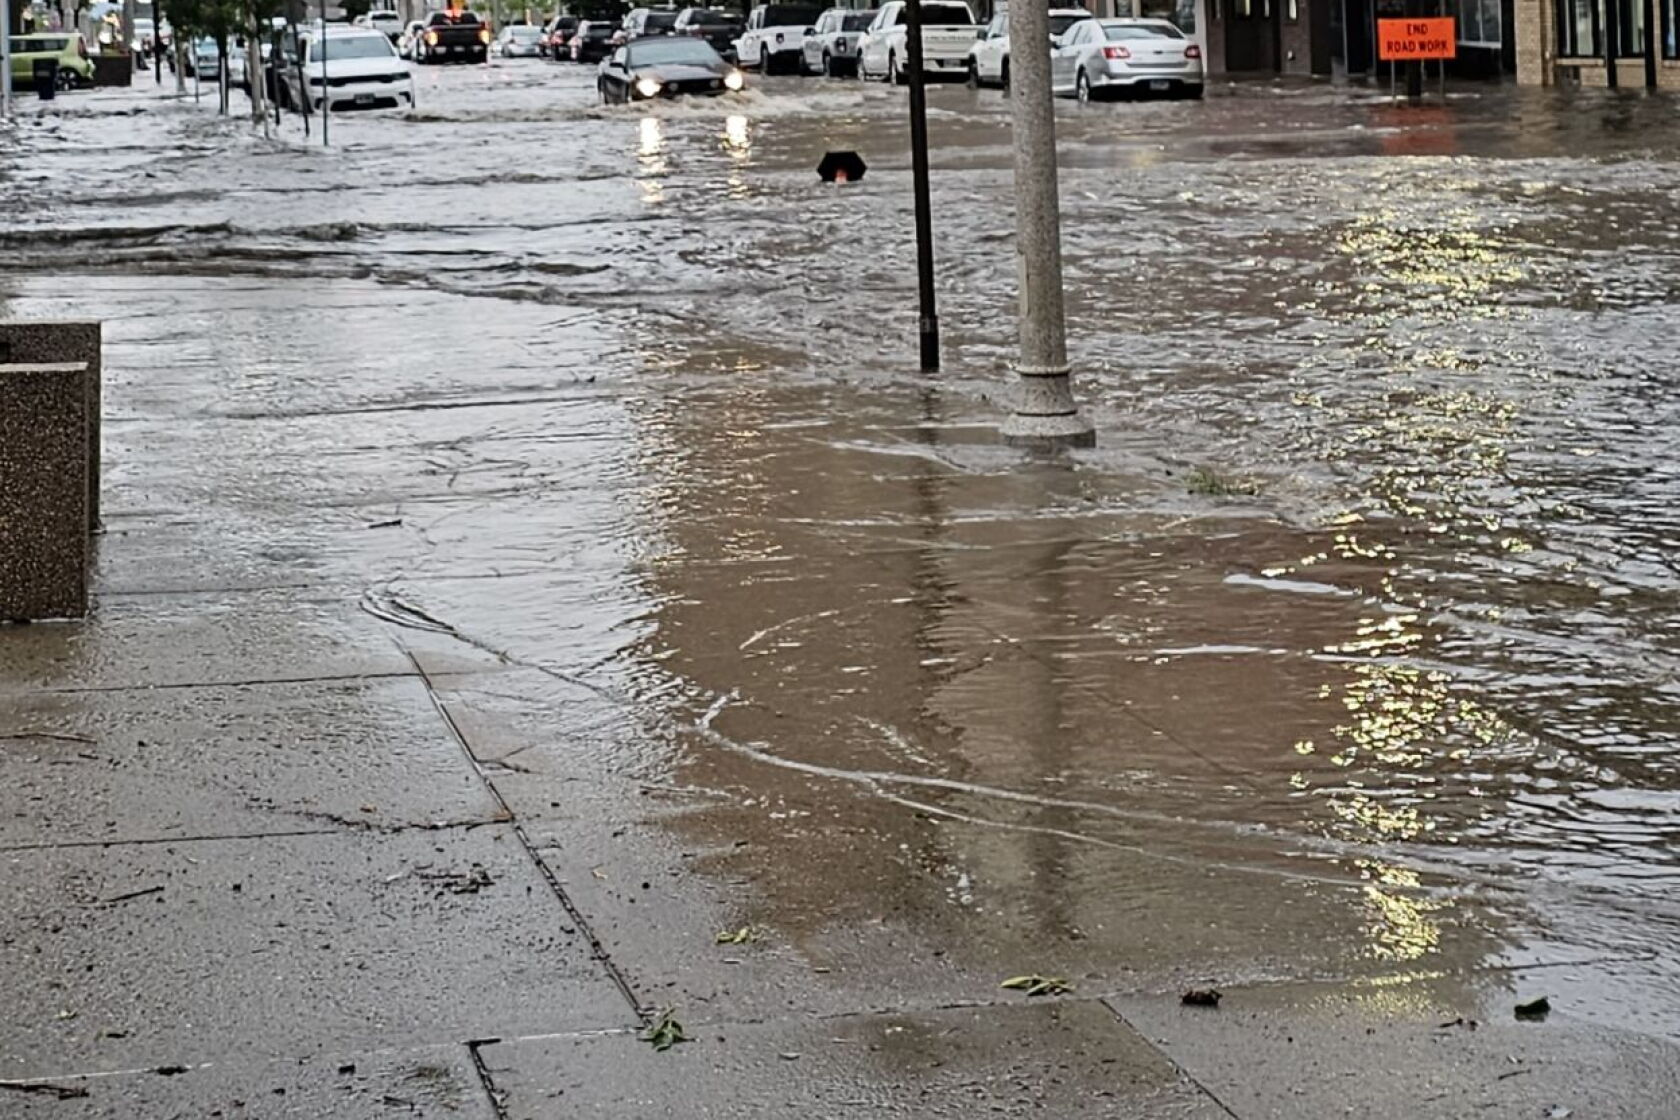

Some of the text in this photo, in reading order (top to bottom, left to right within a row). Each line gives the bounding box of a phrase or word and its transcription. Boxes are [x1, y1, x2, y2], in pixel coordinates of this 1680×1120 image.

[1407, 23, 1429, 36] END
[1386, 39, 1448, 53] ROAD WORK
